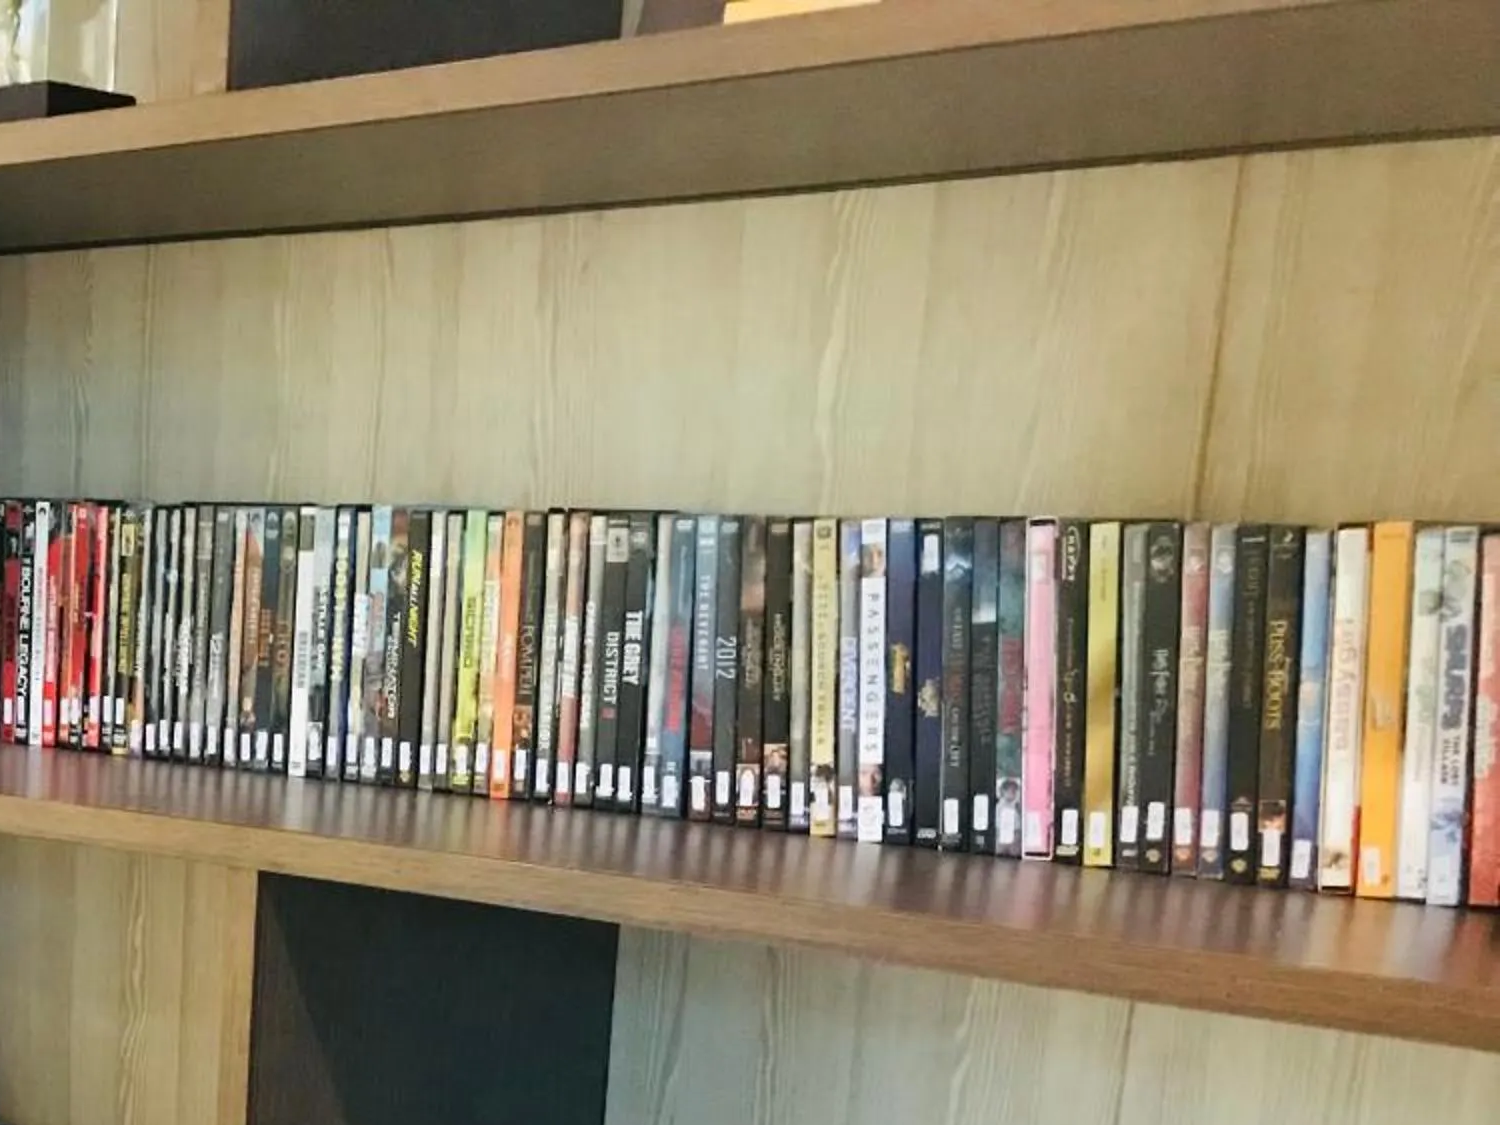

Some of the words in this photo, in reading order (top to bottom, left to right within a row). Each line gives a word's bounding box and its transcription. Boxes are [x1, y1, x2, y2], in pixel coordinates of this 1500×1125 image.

[19, 566, 33, 630] BOURNE
[625, 609, 644, 641] THE
[17, 634, 31, 697] LEGACY
[603, 631, 620, 705] DISTRICT
[621, 643, 642, 685] GREY
[715, 635, 737, 680] 2012
[863, 592, 882, 754] PASSENGERS
